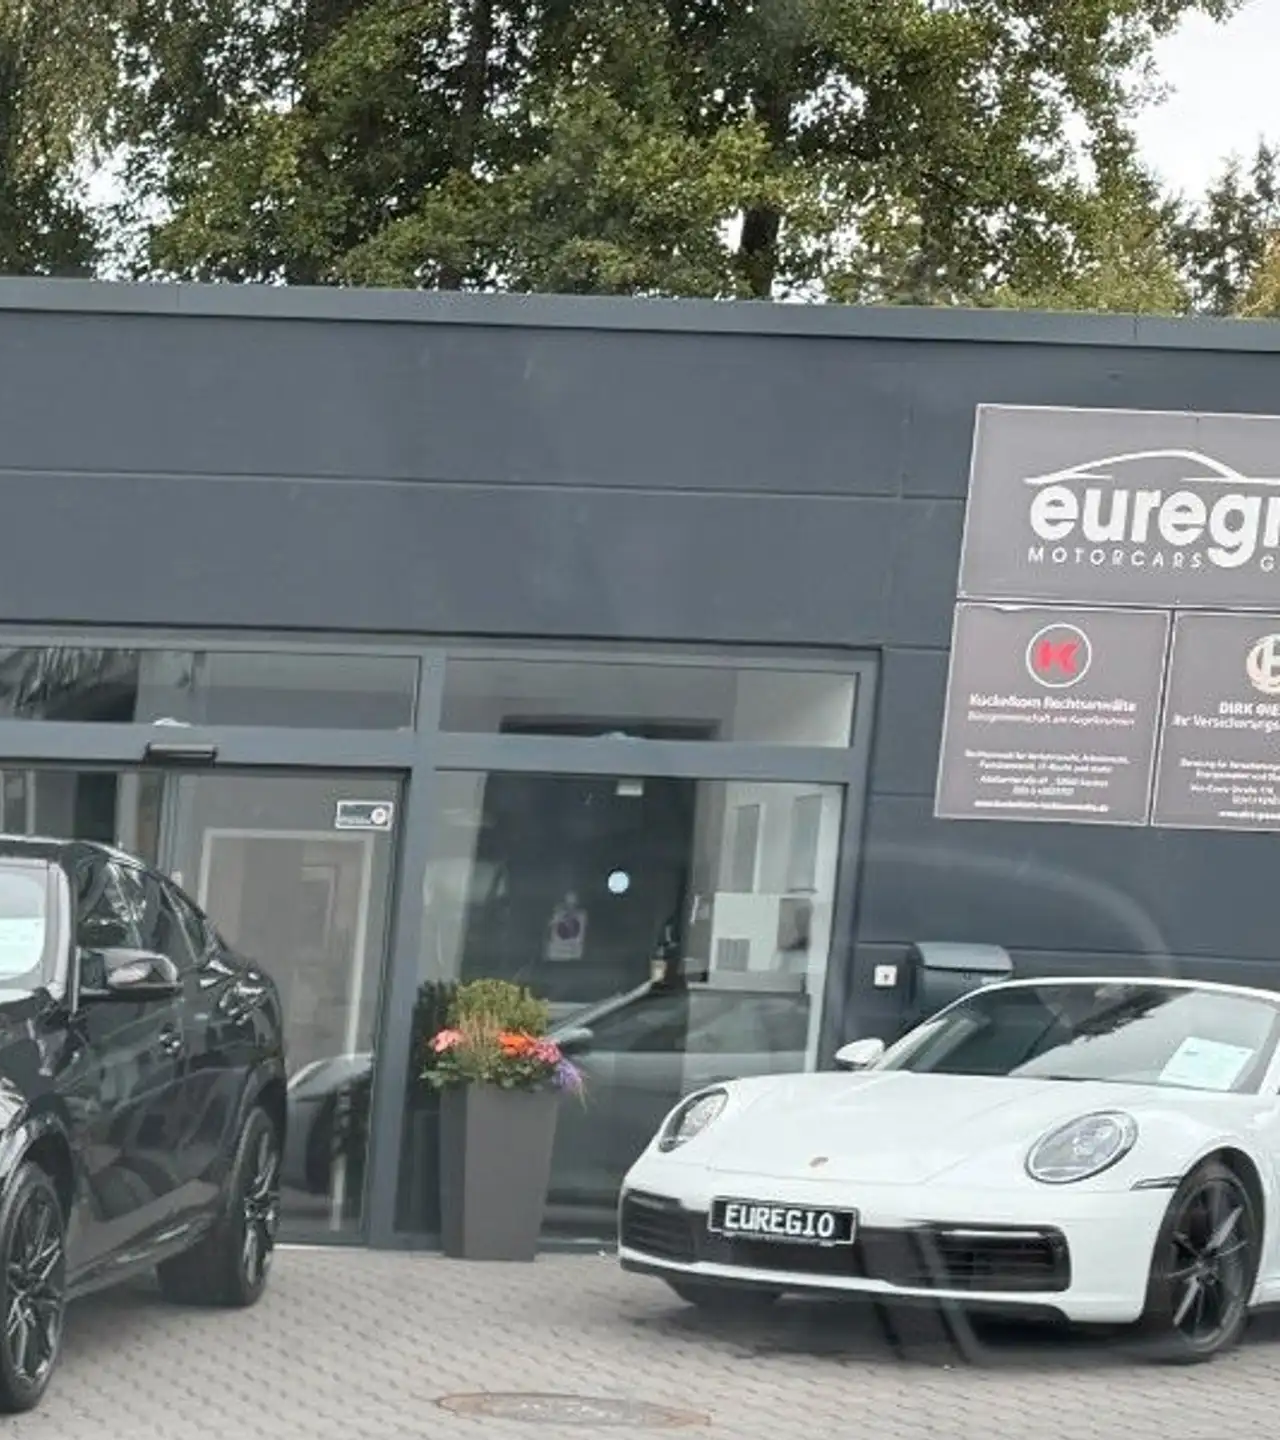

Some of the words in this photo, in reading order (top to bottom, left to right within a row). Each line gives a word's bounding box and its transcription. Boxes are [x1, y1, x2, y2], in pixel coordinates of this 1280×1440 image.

[1028, 547, 1202, 568] MOTORCARS
[1219, 701, 1253, 715] DIRK
[724, 1203, 835, 1238] EUREGIO
